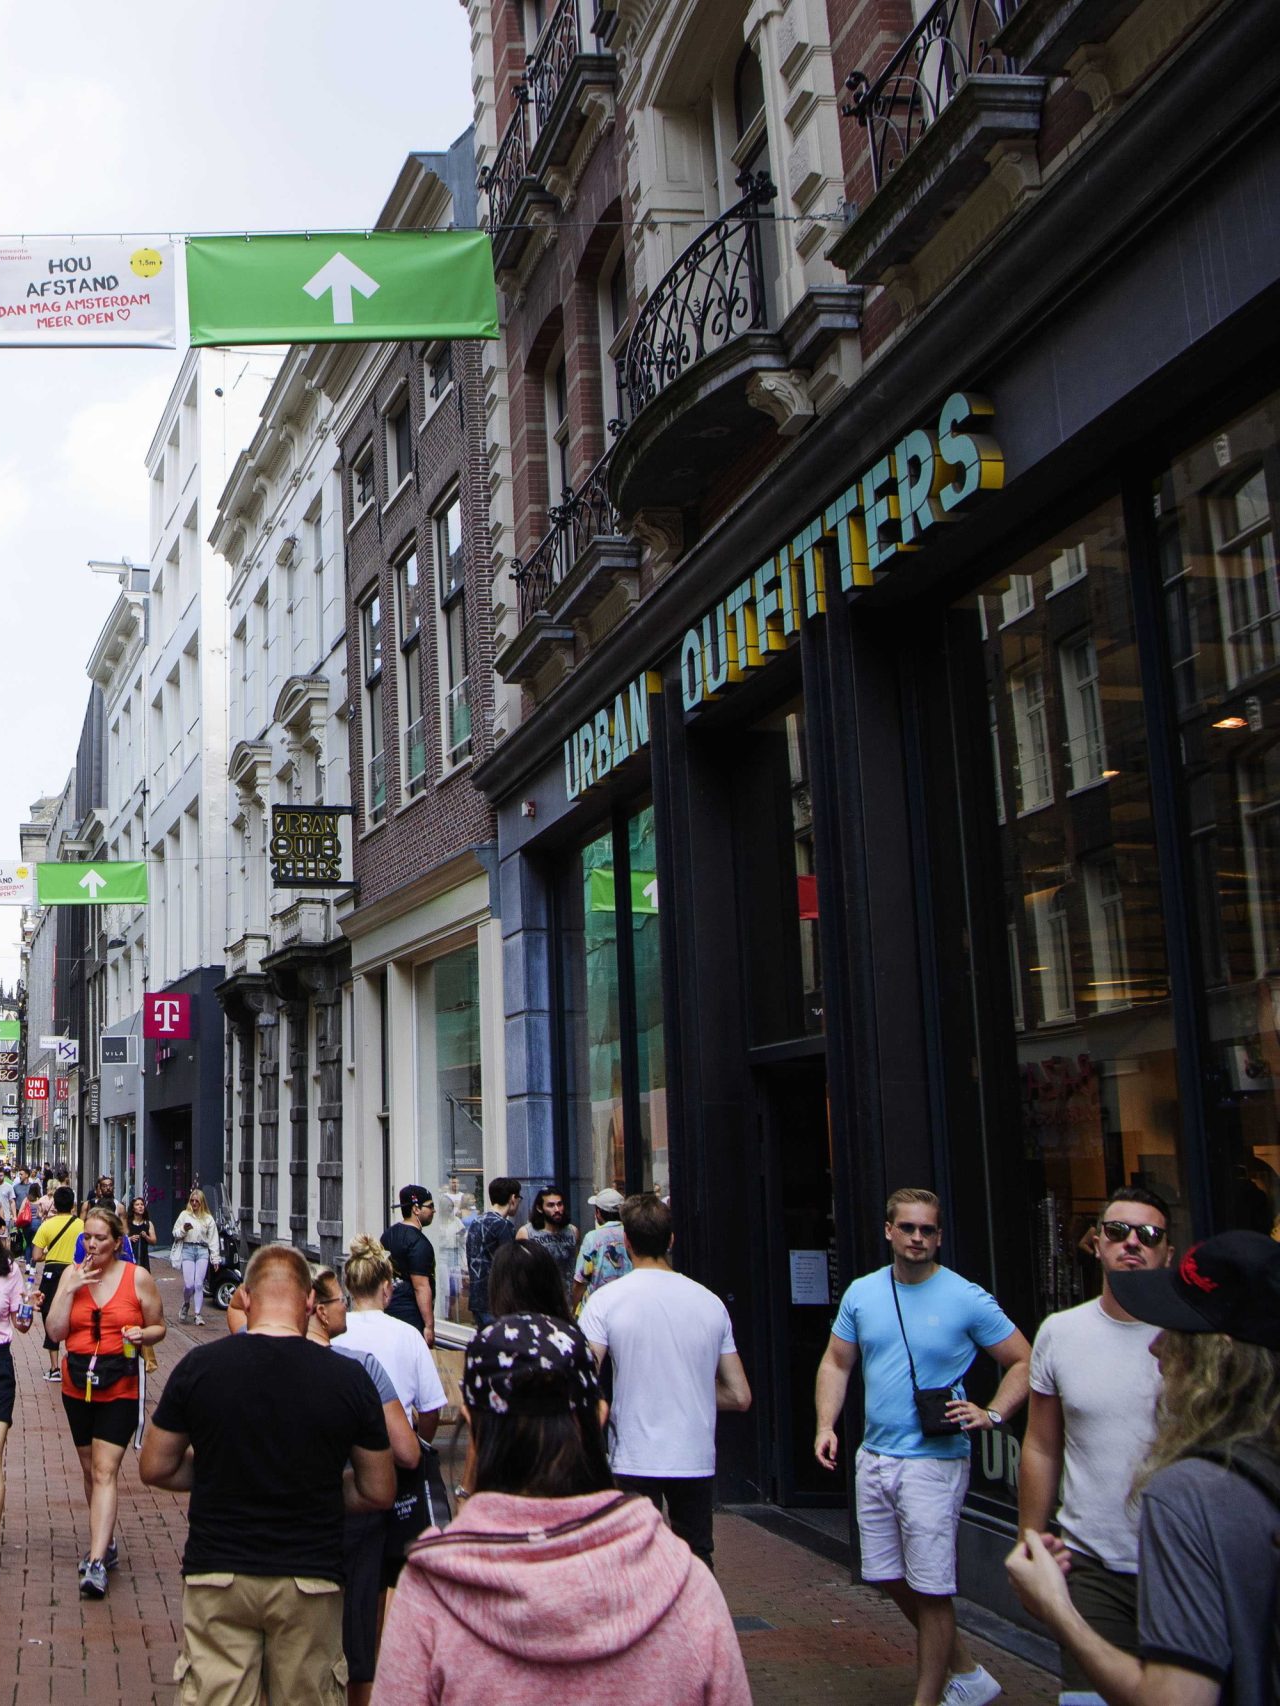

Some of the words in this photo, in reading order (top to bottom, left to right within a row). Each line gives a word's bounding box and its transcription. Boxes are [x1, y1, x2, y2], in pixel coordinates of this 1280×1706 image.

[48, 256, 92, 274] HOU
[26, 275, 119, 298] AFSTAND
[30, 301, 61, 314] MAG
[65, 293, 151, 311] AMSTERDAM
[37, 315, 73, 329] MEER
[77, 312, 114, 326] OPEN
[680, 392, 1006, 713] OUTFITTERS
[564, 671, 662, 802] URBAN
[273, 812, 338, 835] URBAN
[28, 1089, 45, 1098] QLO
[91, 1084, 99, 1124] MANFIELD
